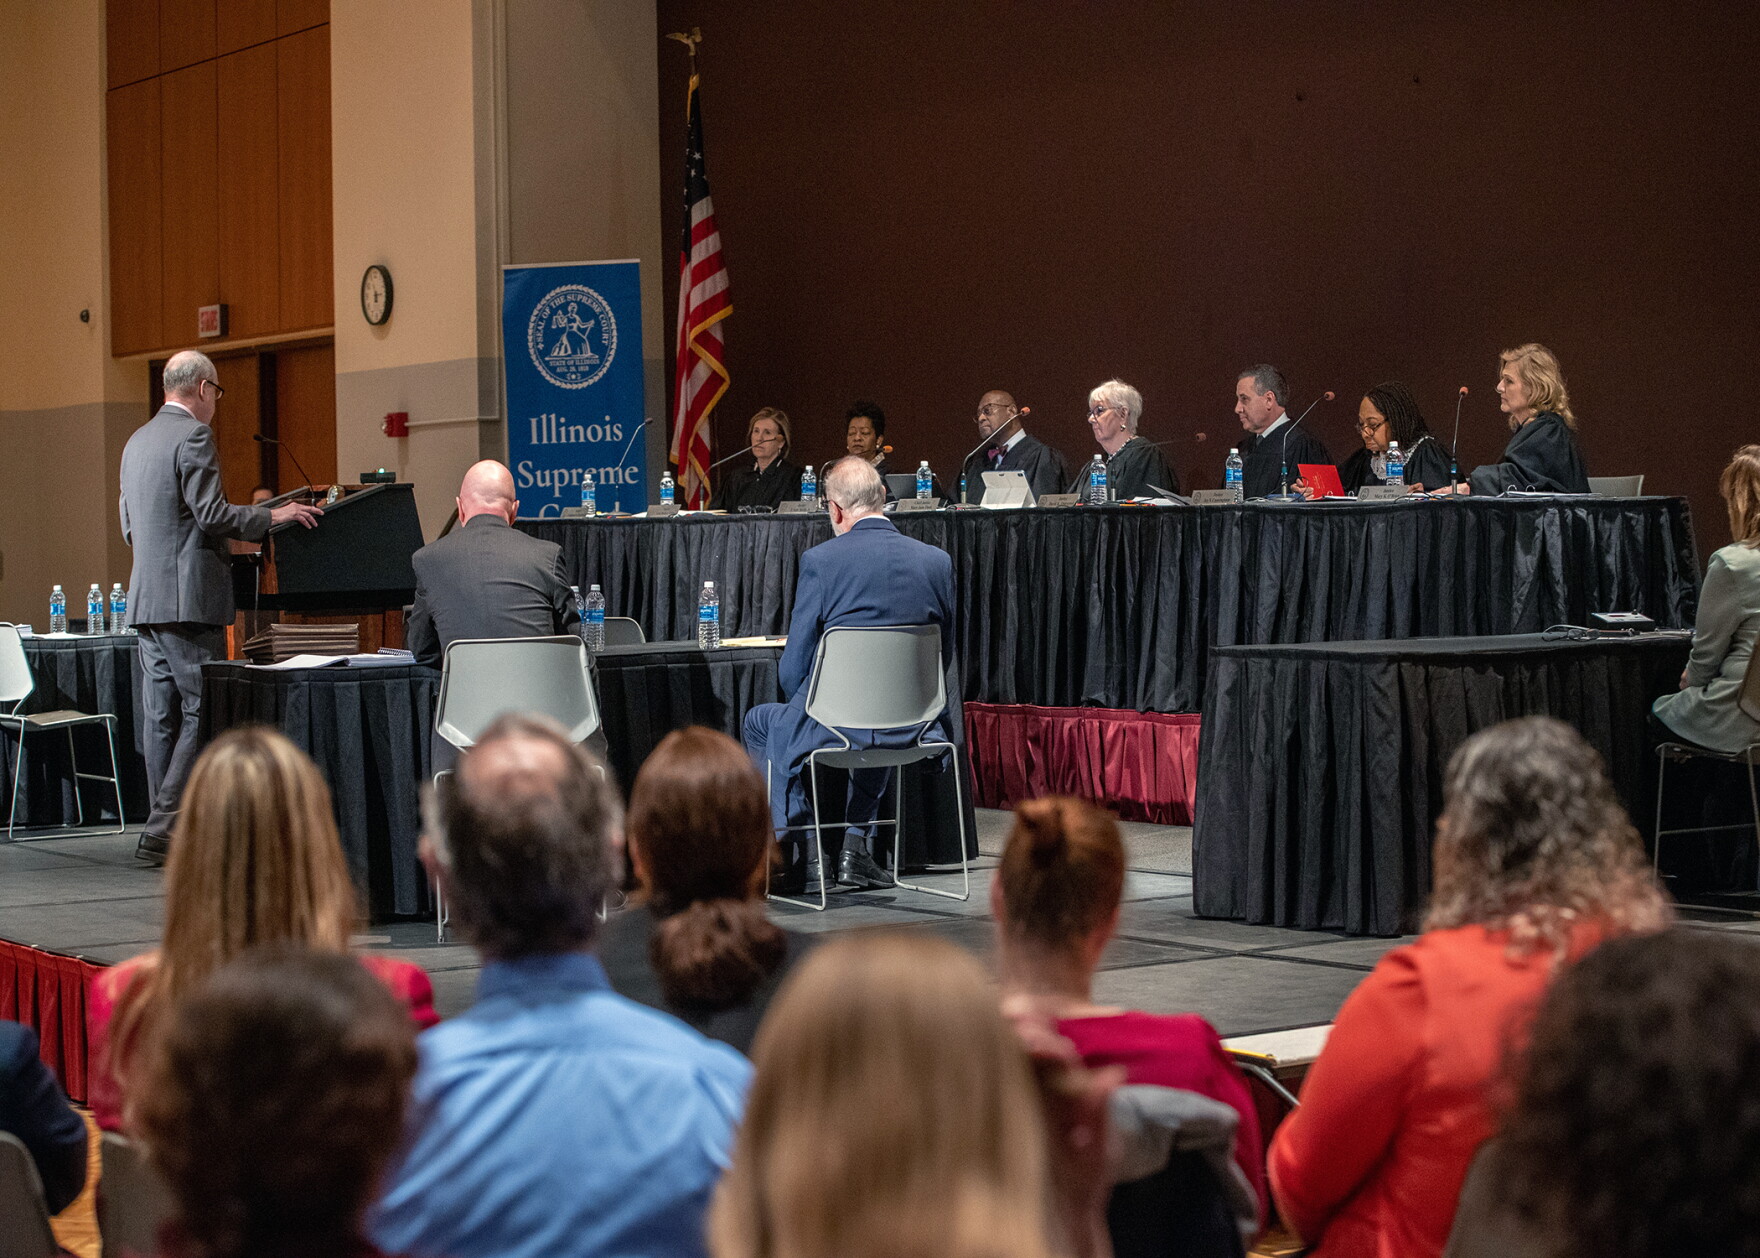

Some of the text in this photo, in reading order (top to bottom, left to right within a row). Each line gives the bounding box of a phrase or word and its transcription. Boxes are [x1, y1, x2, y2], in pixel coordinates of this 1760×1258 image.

[535, 294, 609, 345] SEAL OF THE SUPREME COURT
[529, 413, 624, 445] Illinois
[517, 460, 640, 498] Supreme
